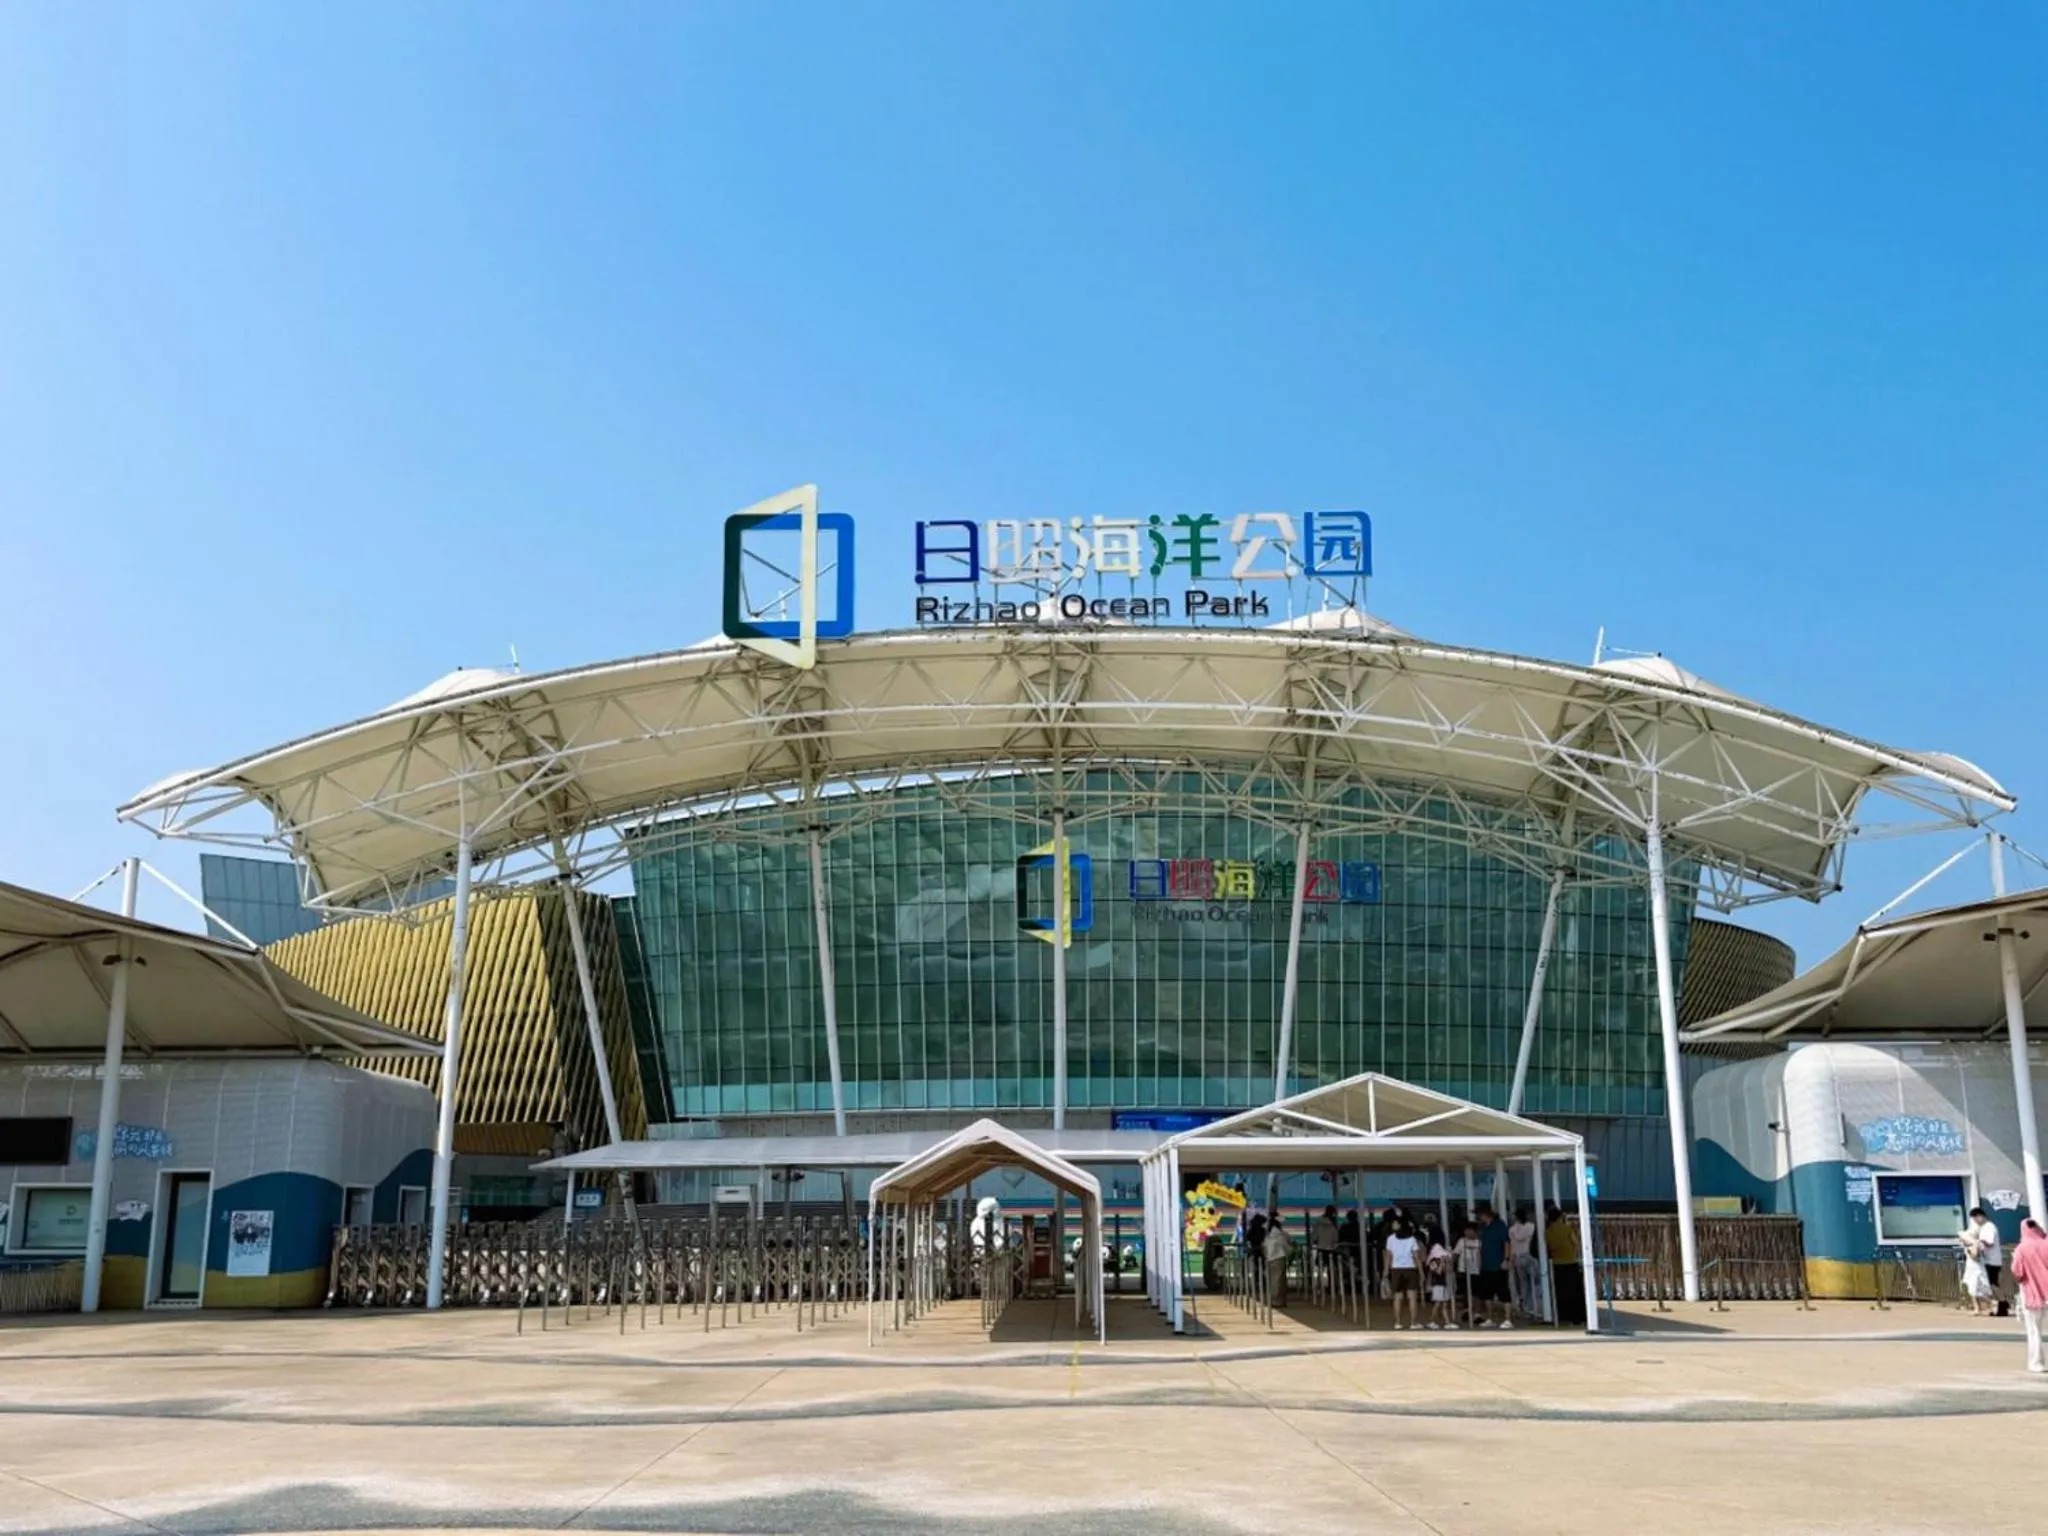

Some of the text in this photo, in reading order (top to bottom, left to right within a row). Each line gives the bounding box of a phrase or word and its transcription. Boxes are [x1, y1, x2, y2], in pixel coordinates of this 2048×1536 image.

[914, 510, 1373, 584] 日照海洋公园
[915, 589, 1269, 622] Rizhao Ocean Park
[1130, 858, 1379, 902] 日照海洋公园
